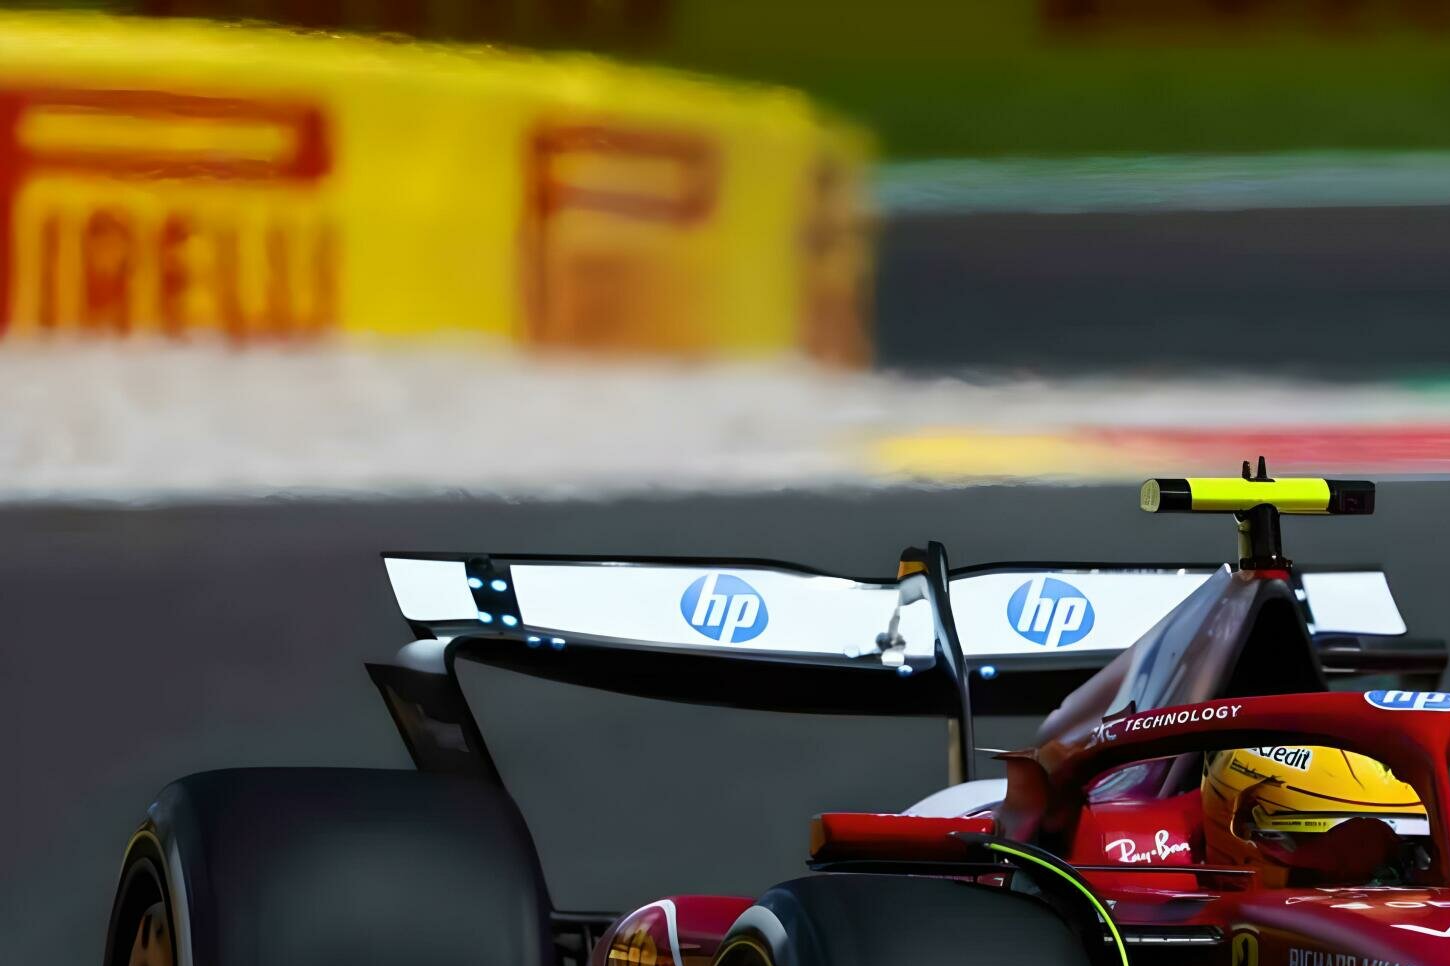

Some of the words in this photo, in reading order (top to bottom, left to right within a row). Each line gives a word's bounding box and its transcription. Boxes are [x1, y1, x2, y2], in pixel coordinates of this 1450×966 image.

[690, 573, 761, 643] hp
[1016, 577, 1089, 647] hp
[1124, 704, 1243, 732] TECHNOLOGY
